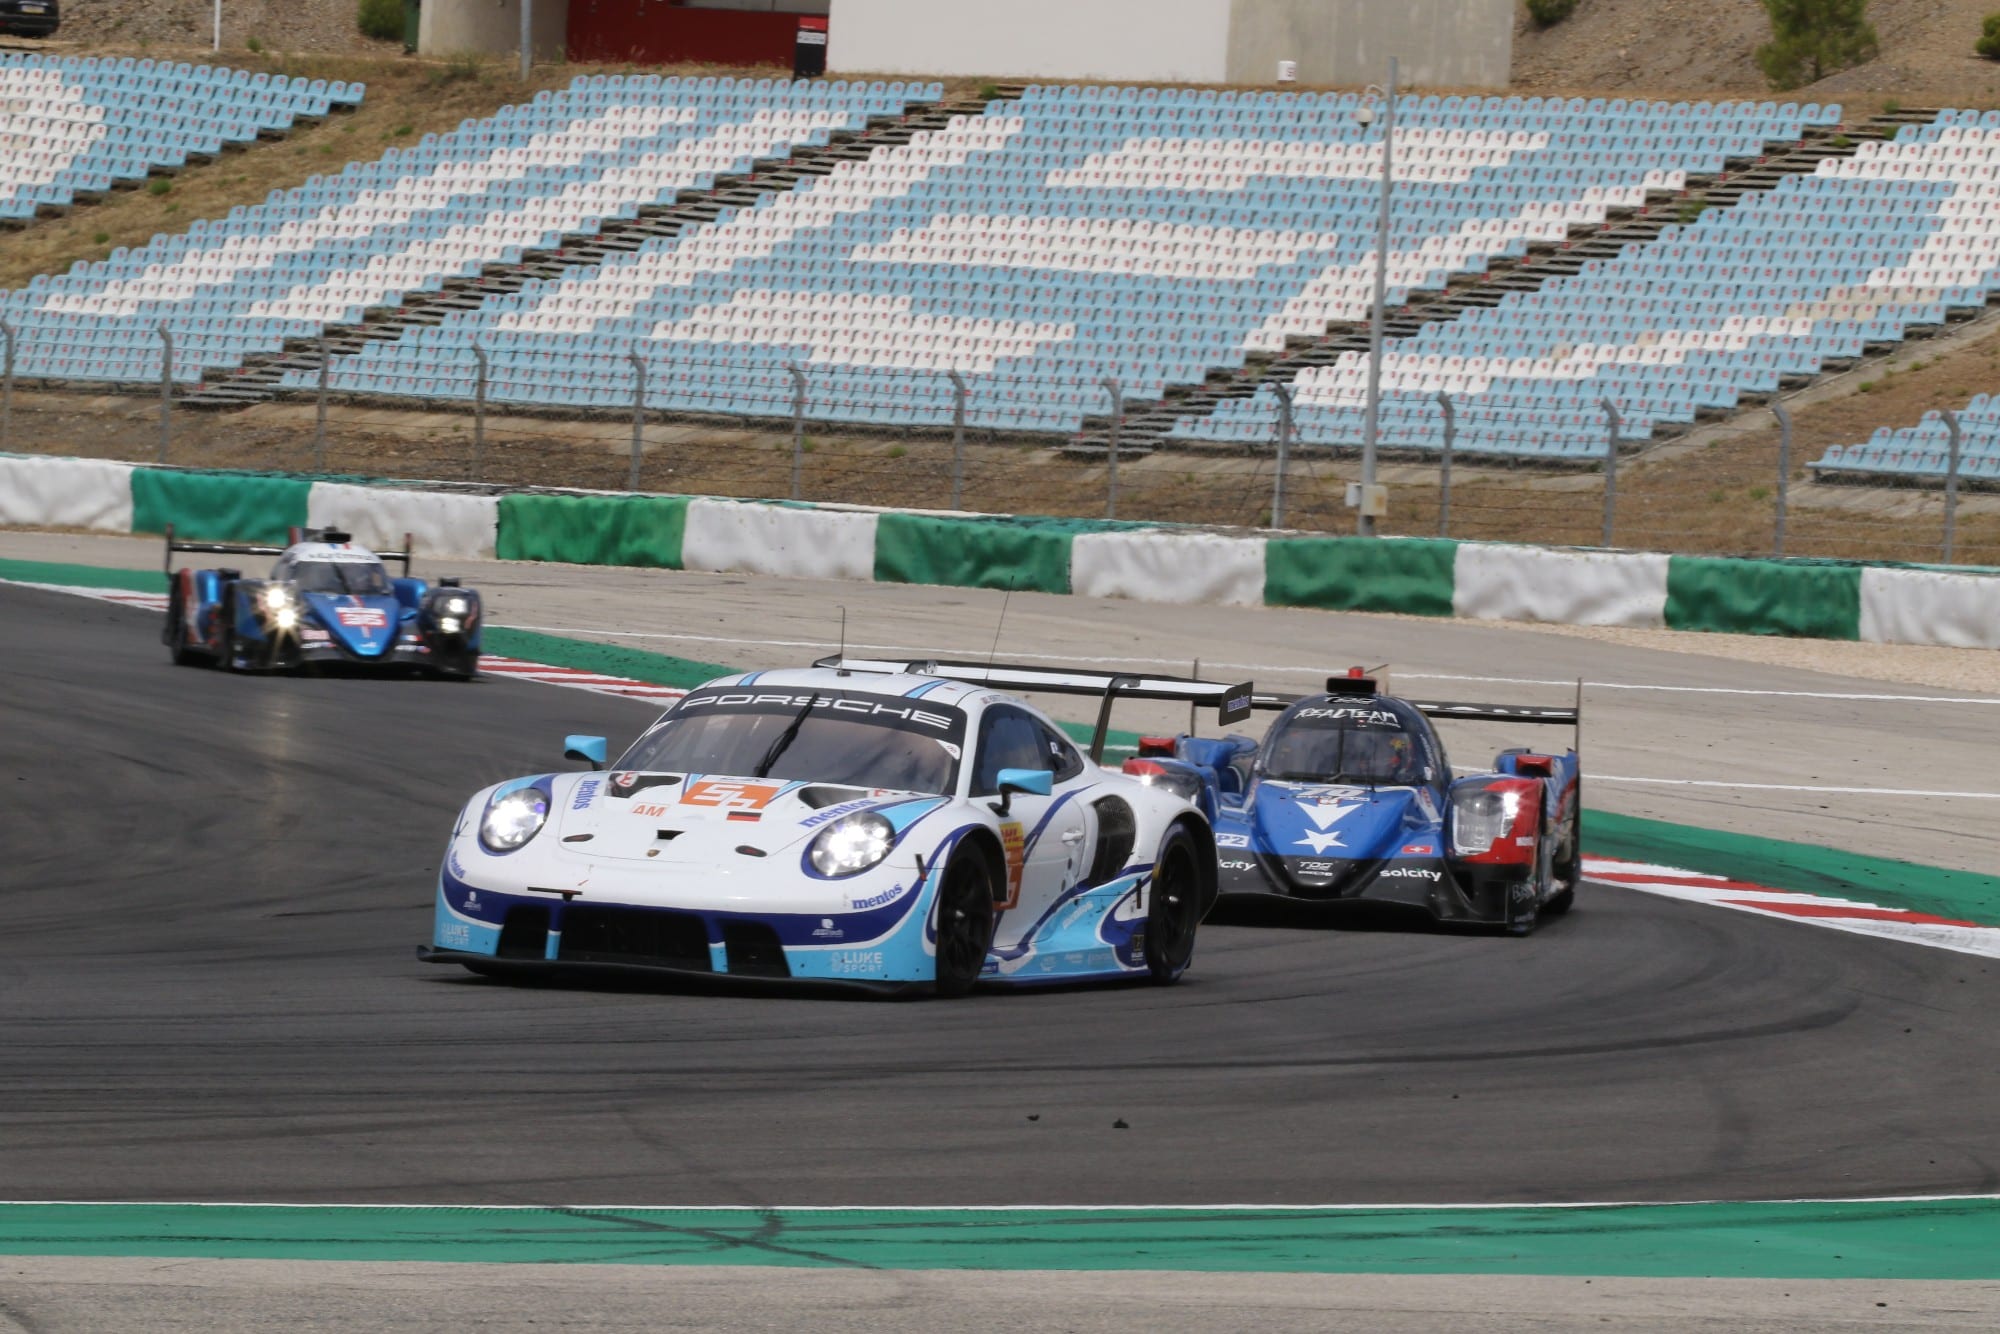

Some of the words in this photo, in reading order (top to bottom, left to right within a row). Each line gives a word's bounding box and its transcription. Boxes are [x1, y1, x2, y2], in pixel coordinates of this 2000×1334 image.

[680, 694, 953, 730] PORSCHE
[1294, 708, 1399, 724] REALTEAM
[572, 780, 601, 810] mentos
[632, 804, 666, 817] AM
[799, 800, 877, 828] mentos
[1379, 867, 1442, 882] solcity
[852, 883, 903, 909] mentos
[843, 951, 884, 964] LUKE
[843, 964, 883, 973] SPORT
